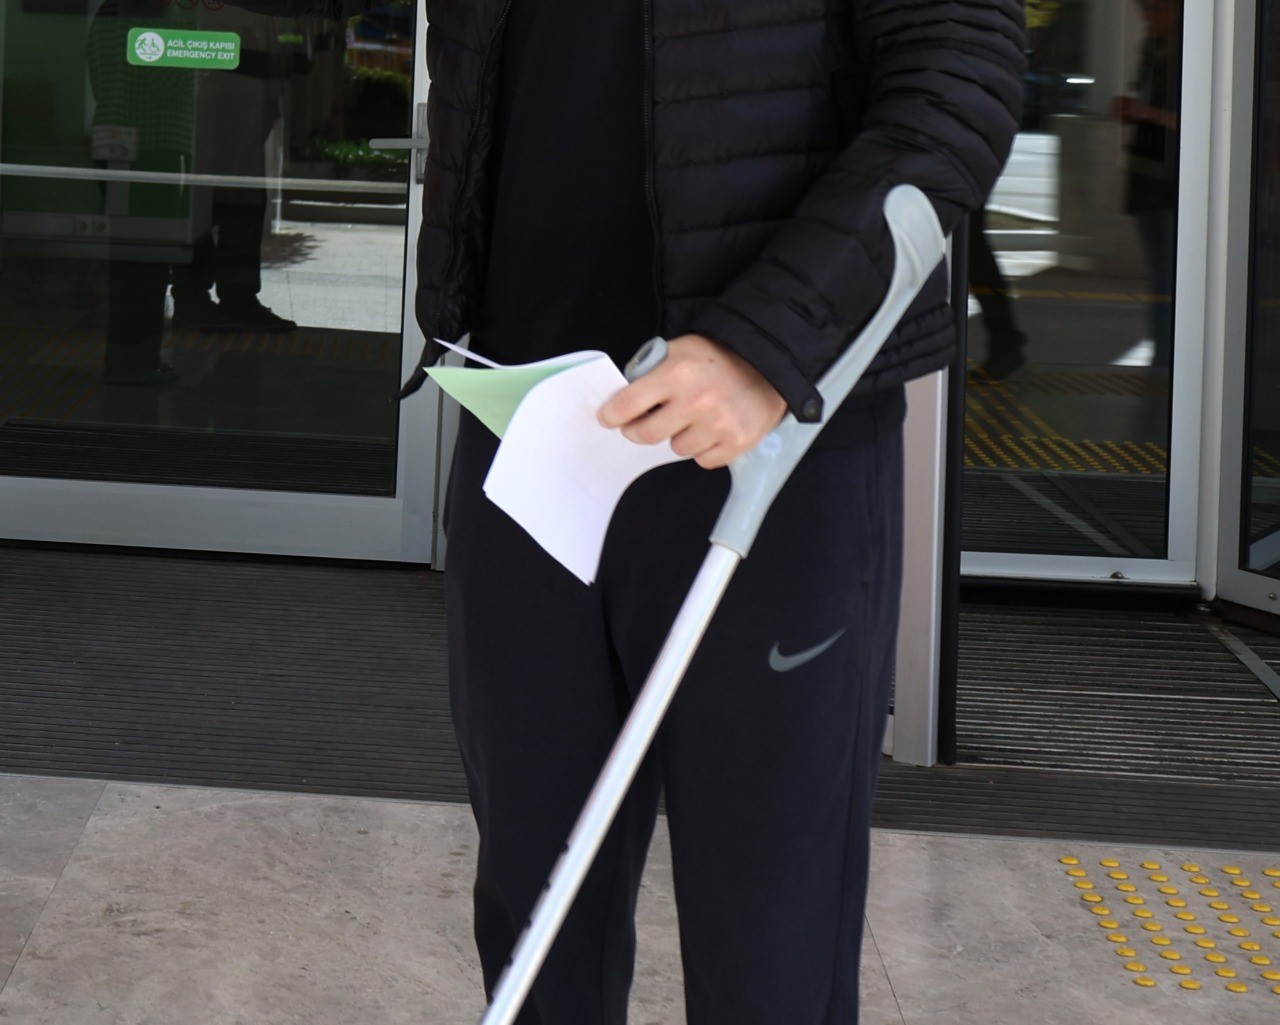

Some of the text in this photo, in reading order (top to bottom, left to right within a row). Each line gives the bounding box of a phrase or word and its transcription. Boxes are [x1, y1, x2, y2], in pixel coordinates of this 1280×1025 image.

[167, 39, 235, 50] ACİL ÇIKIŞ KAPISI
[167, 50, 235, 60] EMERGENCY EXIT
